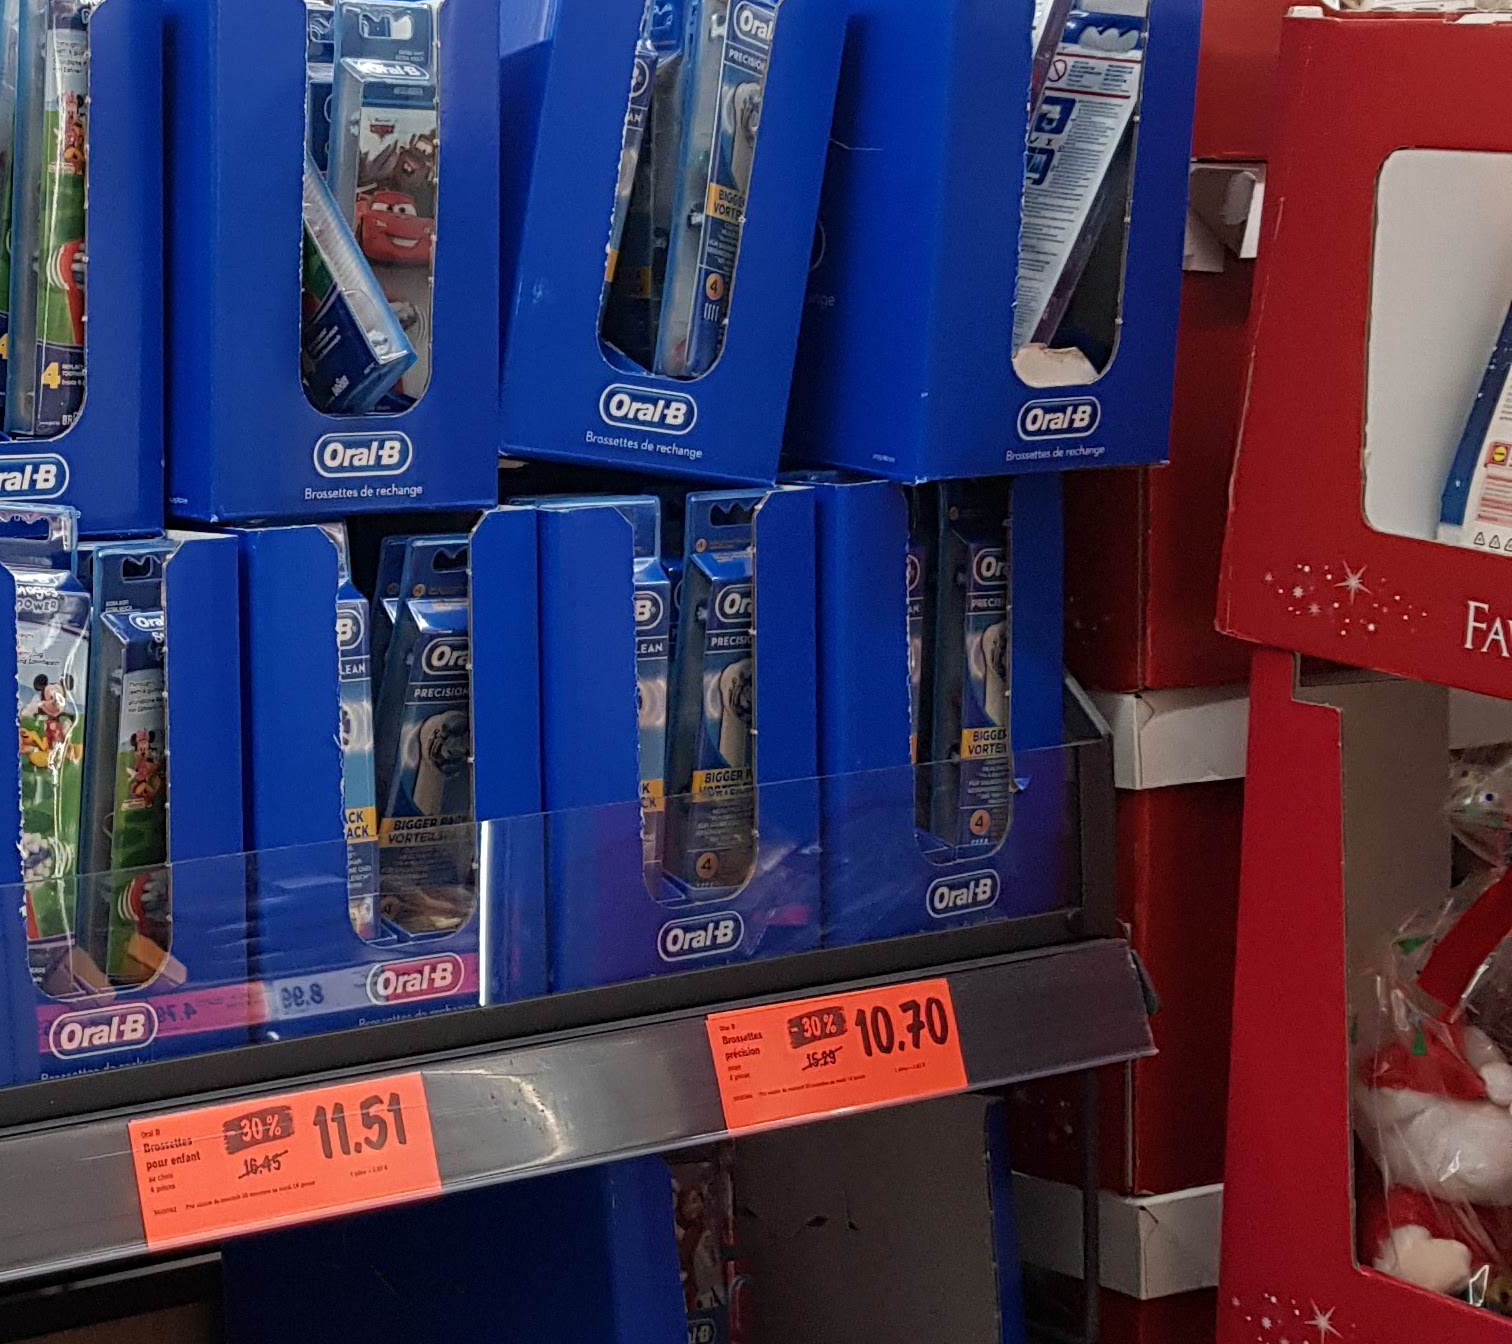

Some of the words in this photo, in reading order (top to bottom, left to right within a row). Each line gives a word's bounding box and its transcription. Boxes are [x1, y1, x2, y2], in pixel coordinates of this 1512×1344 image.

[41, 362, 61, 389] 4
[607, 392, 686, 427] Oral-B
[1025, 403, 1092, 432] Oral-B
[323, 440, 401, 468] Oral-B
[586, 430, 639, 451] Brossettes
[641, 440, 653, 452] de
[655, 443, 703, 460] rechange
[1006, 449, 1049, 462] Brossettes
[304, 487, 356, 501] Brossettes
[359, 486, 372, 498] de
[375, 483, 423, 500] rechange
[340, 662, 366, 675] LEAN
[705, 769, 743, 783] BIGGER
[394, 817, 437, 831] BIGGER
[933, 878, 993, 909] Oral-B
[666, 921, 734, 952] Oral-B
[376, 961, 454, 997] Oral-B
[60, 1013, 145, 1048] Oral-B
[722, 1032, 763, 1045] Brossettes
[855, 997, 949, 1056] 10.70
[725, 1047, 761, 1061] précision
[312, 1093, 407, 1159] 11.51
[143, 1137, 193, 1154] Brossettes
[146, 1159, 168, 1172] pour
[171, 1151, 201, 1165] enfant
[242, 1154, 283, 1177] 16.45
